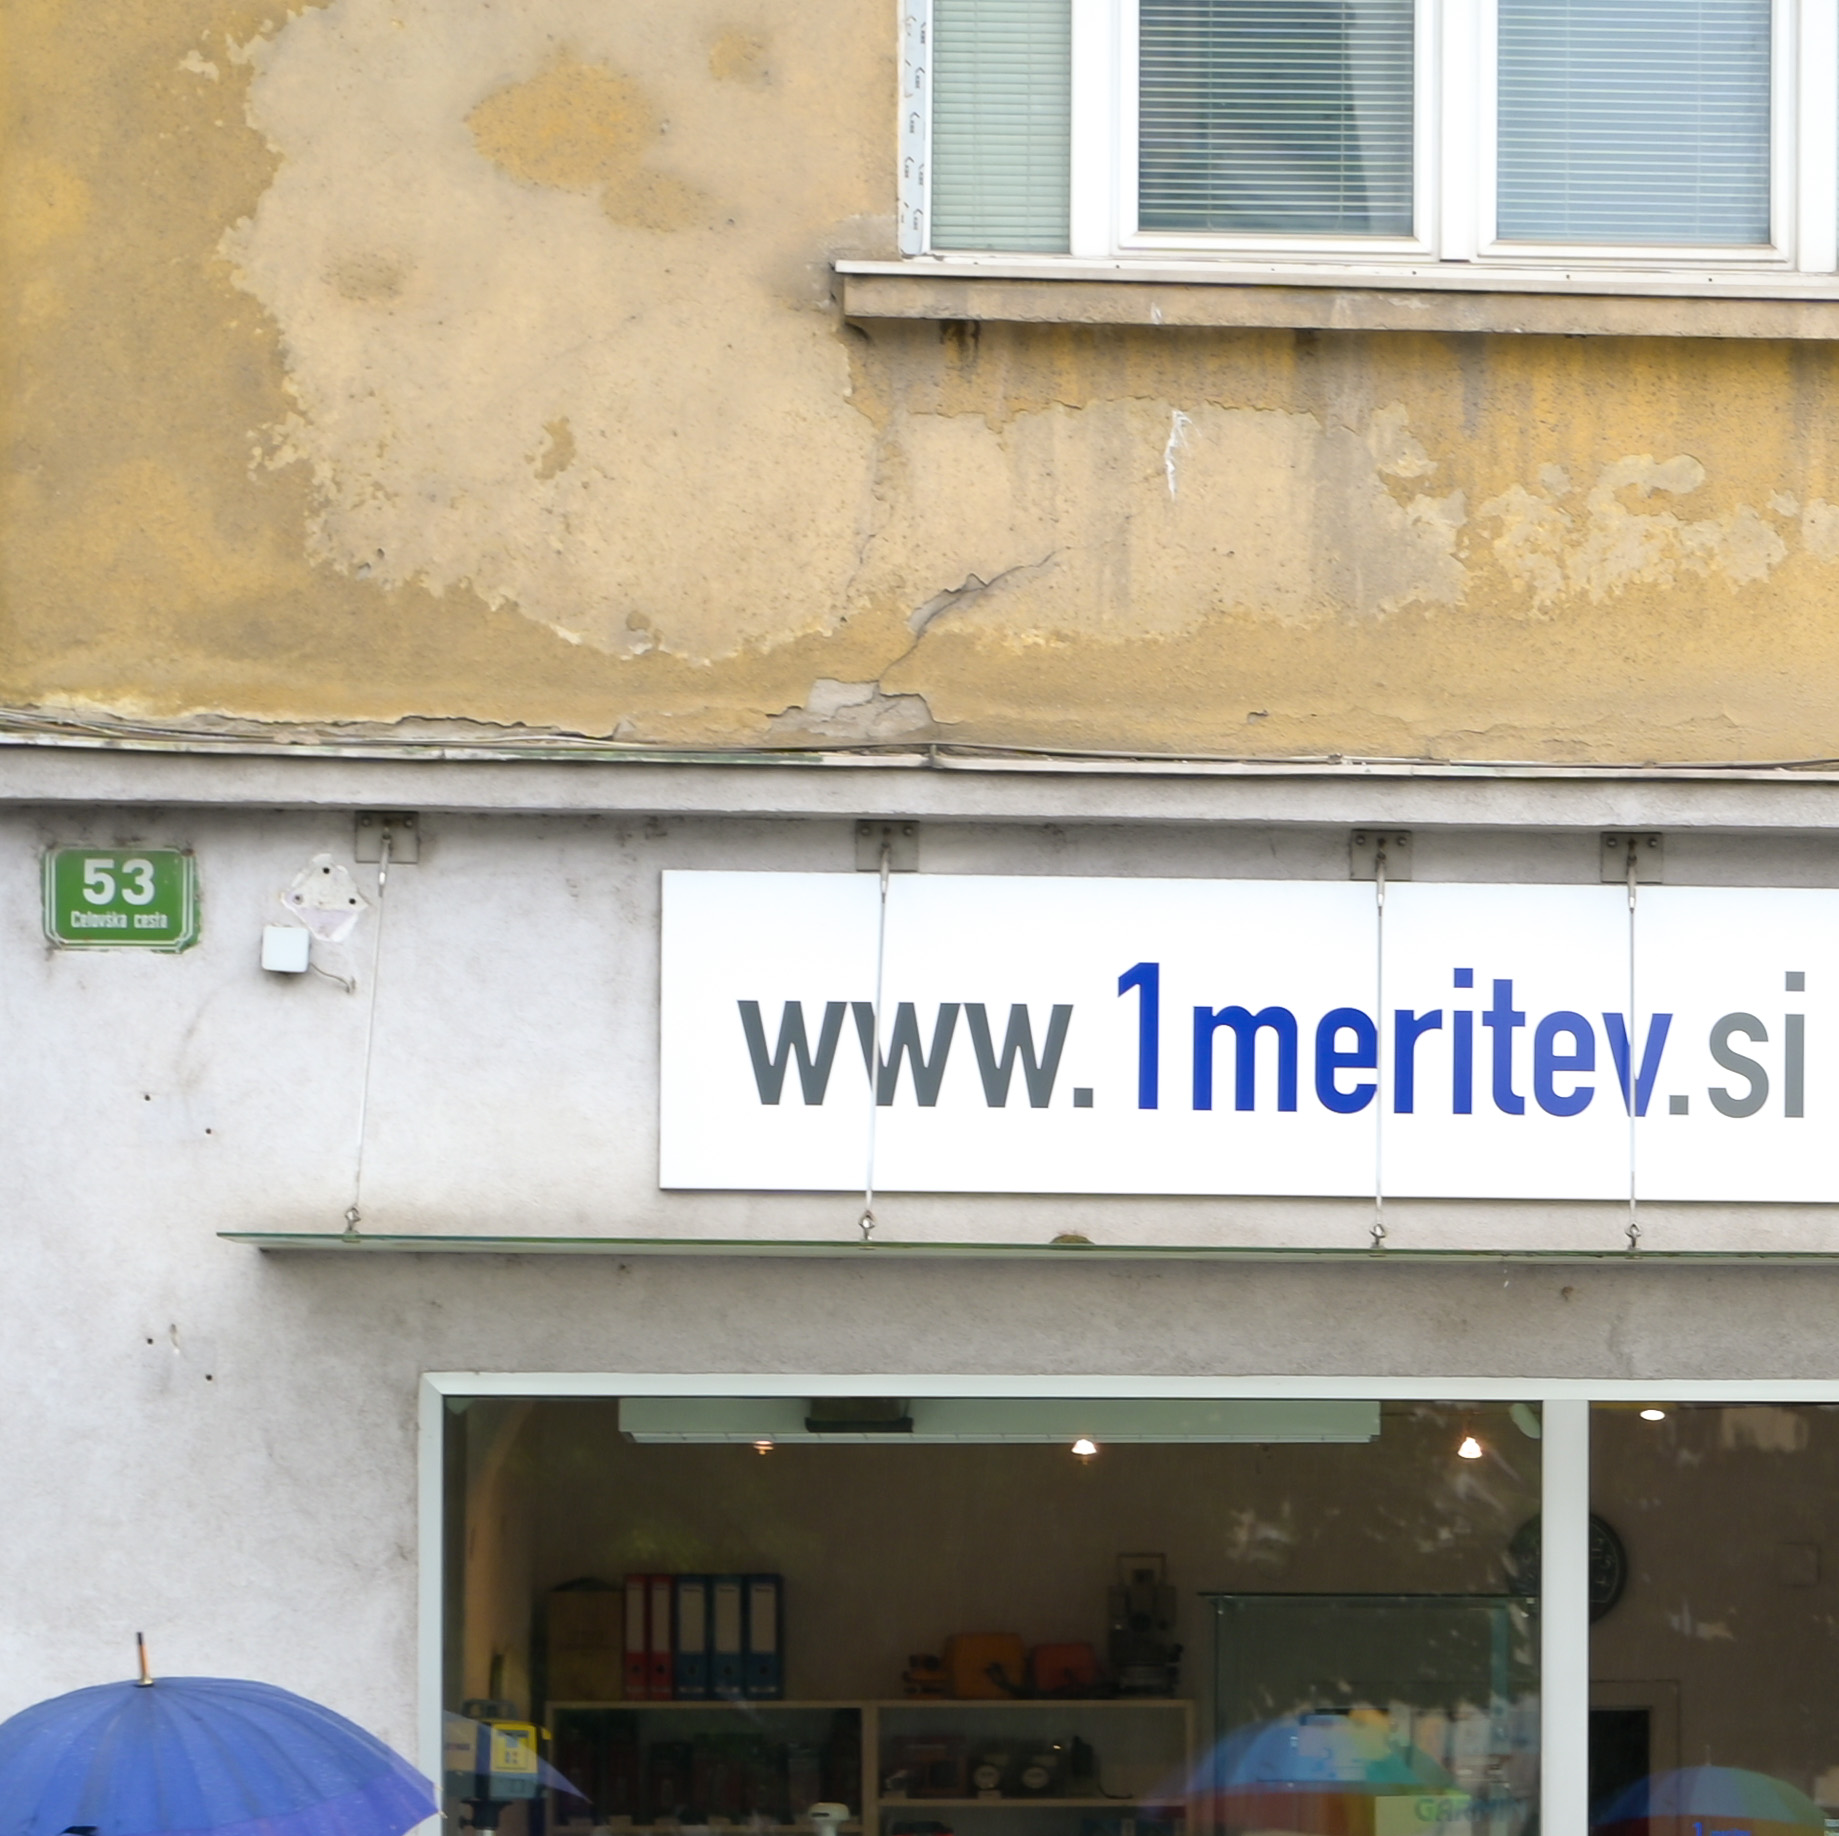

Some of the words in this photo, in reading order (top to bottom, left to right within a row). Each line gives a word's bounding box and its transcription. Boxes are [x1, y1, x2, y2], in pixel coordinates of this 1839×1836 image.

[82, 858, 155, 906] 53
[70, 911, 128, 928] Celovška
[133, 912, 168, 928] cesta
[738, 962, 1806, 1119] www.1meritev.si
